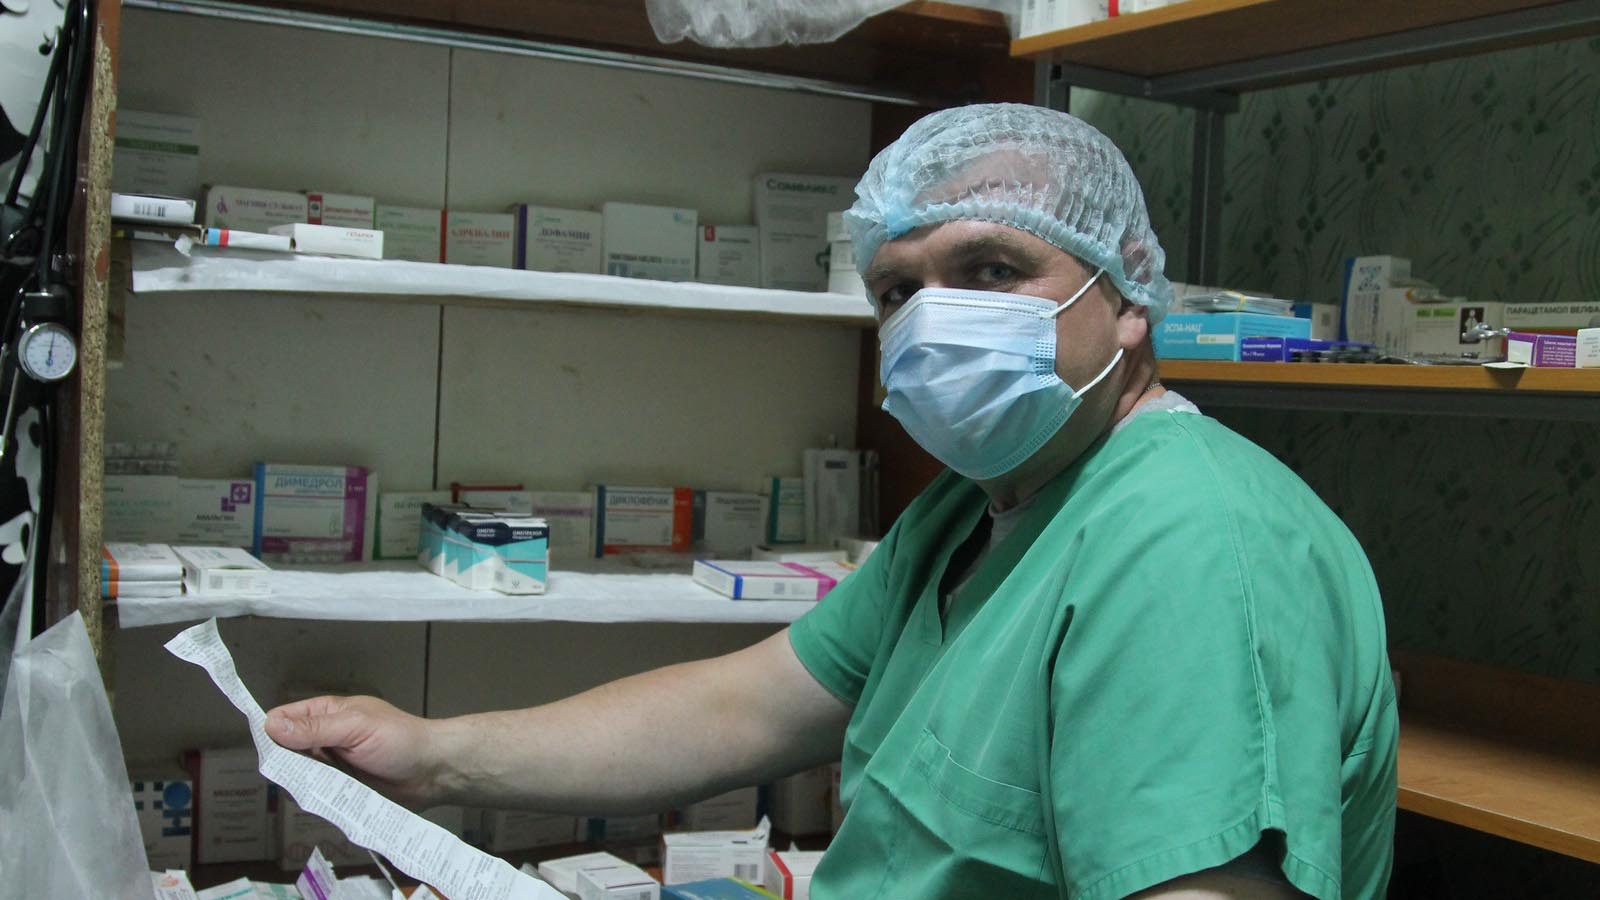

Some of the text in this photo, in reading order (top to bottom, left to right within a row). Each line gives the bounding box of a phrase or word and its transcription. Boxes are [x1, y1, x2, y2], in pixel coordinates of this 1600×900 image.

[1506, 305, 1568, 315] ПАРАЦЕТАМОЛ
[274, 477, 343, 489] ДИМЕДРОЛ
[609, 496, 670, 506] ДИКЛОФЕНАК
